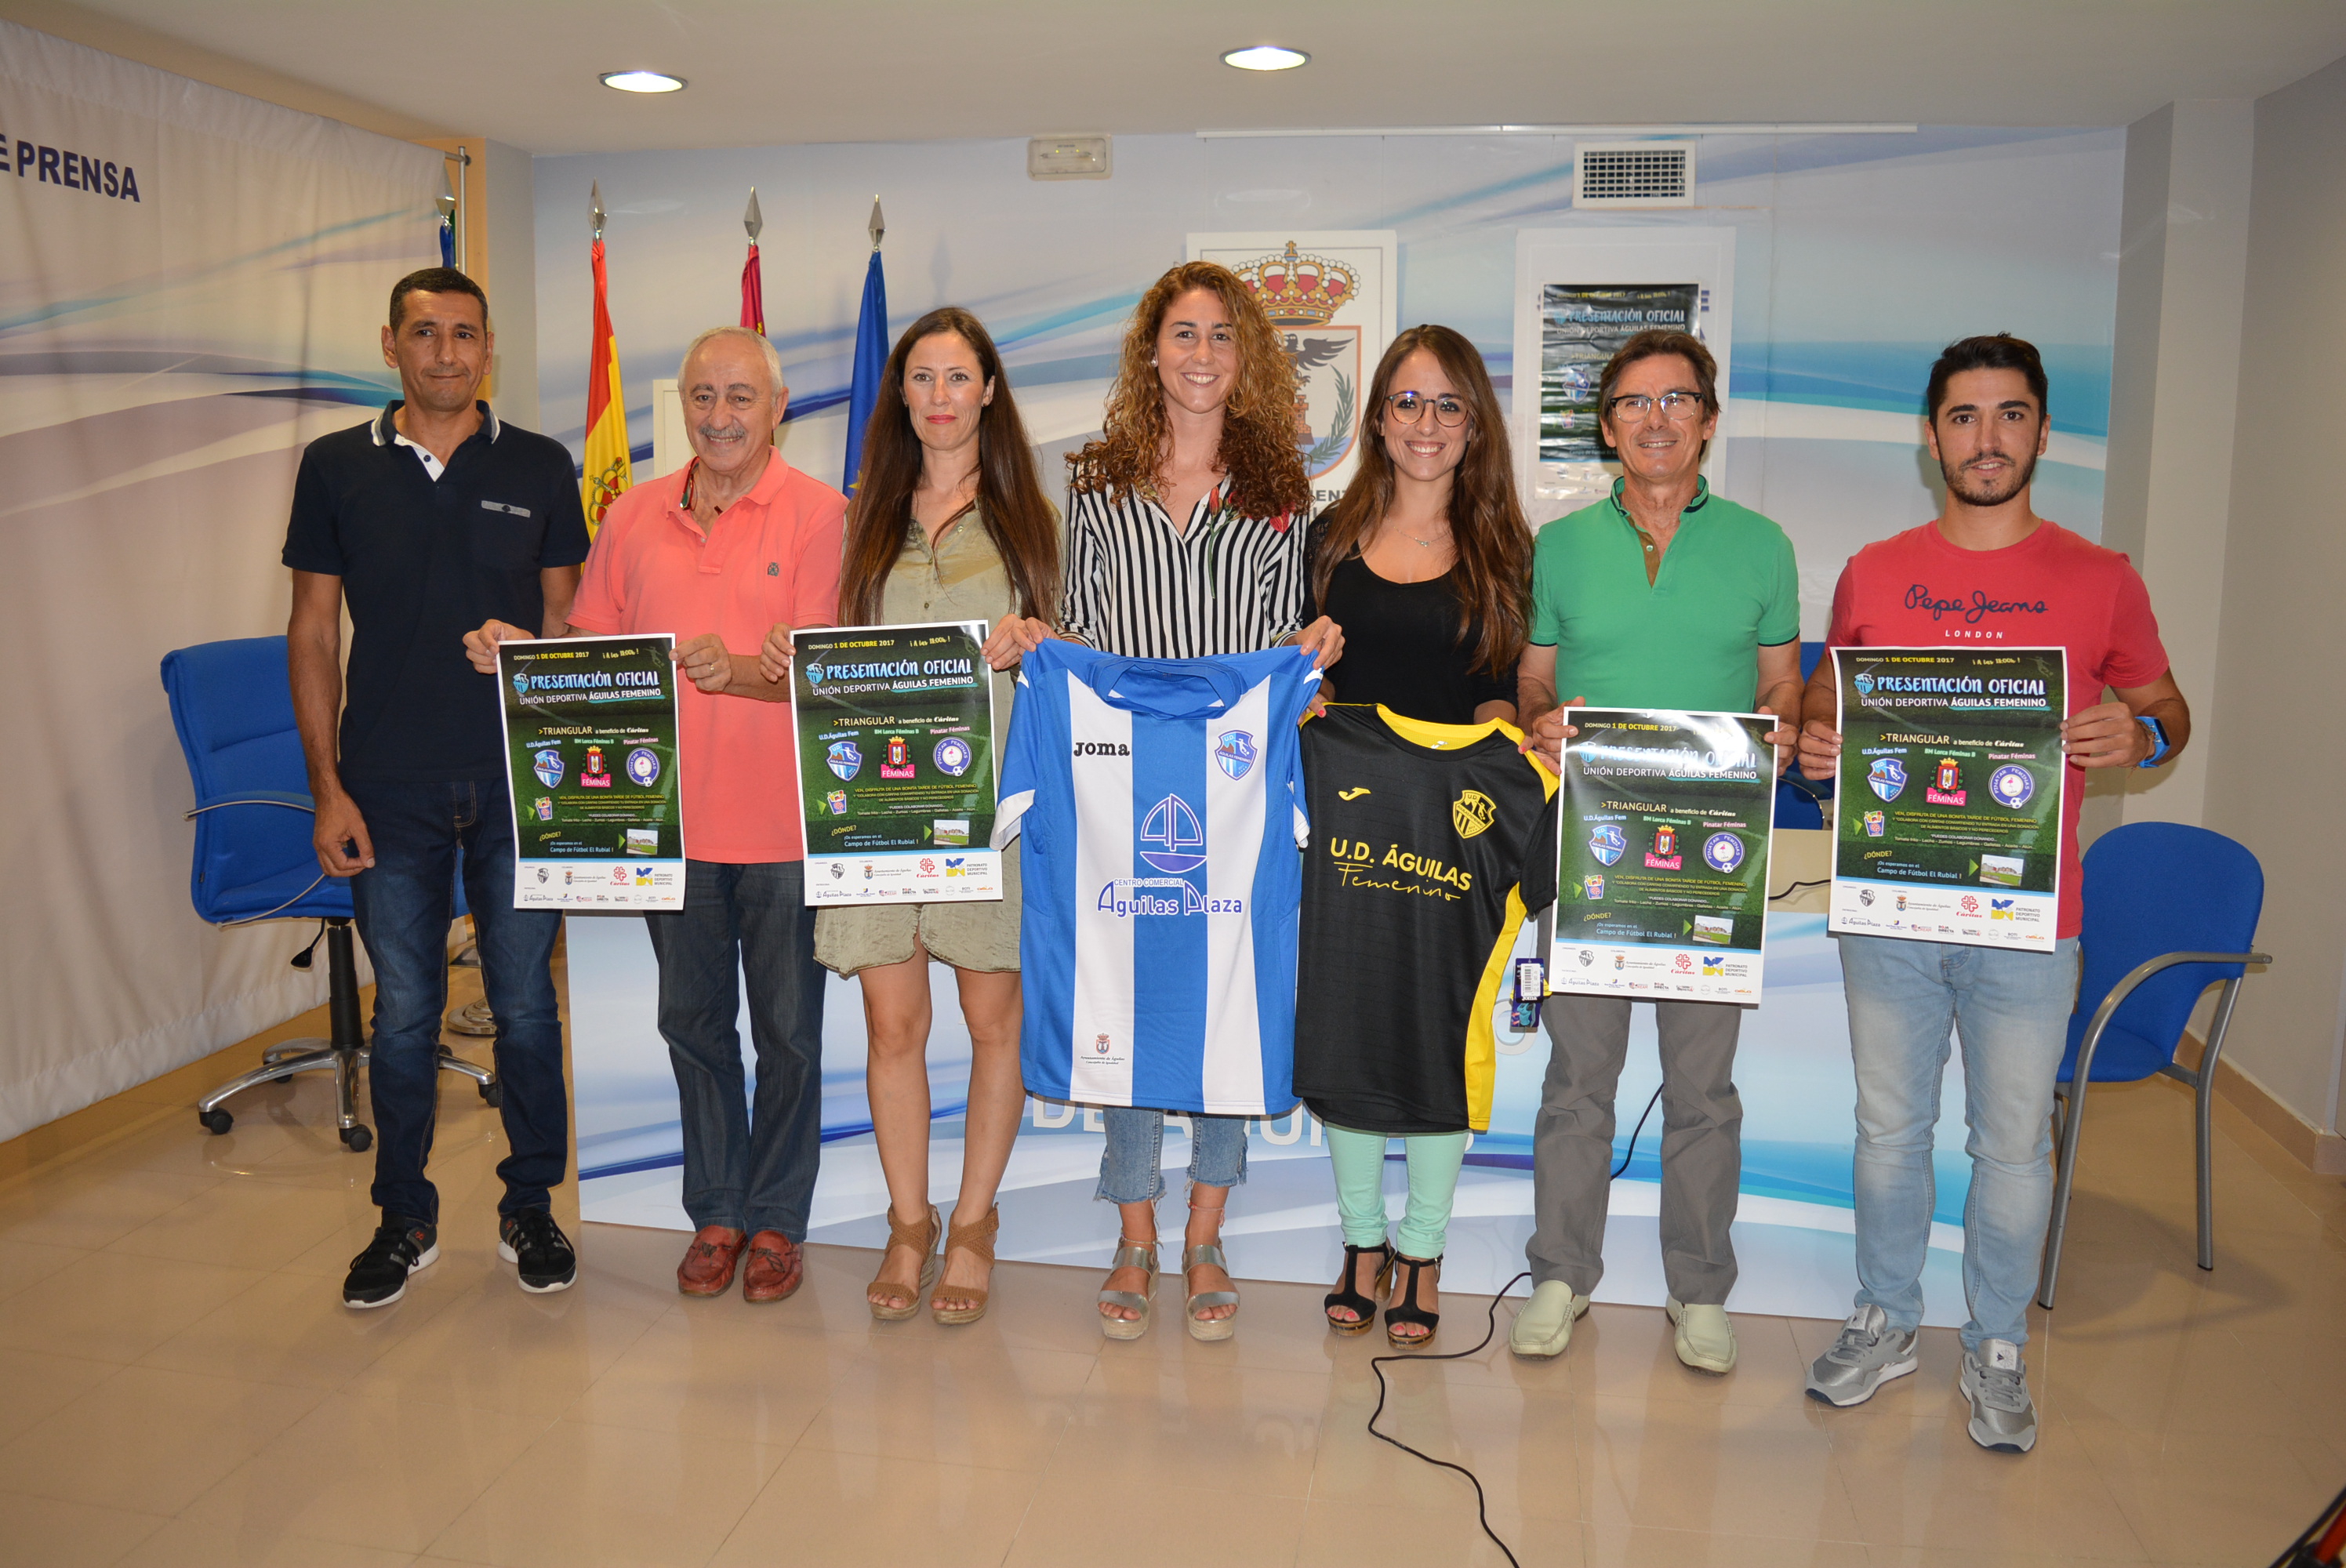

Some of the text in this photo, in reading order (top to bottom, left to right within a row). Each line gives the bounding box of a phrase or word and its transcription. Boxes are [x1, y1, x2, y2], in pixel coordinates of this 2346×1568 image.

[17, 140, 140, 203] PRENSA
[1647, 310, 1685, 322] OFICIAL
[1905, 584, 2049, 624] Pepe Jeans
[1945, 630, 2003, 638] LONDON
[826, 659, 972, 680] PRESENTACIÓN OFICIAL
[531, 671, 660, 690] PRESENTACIÓN OFICIAL
[812, 677, 974, 696] UNIÓN DEPORTIVA ÁGUILAS FEMENINO
[1877, 676, 2046, 696] PRESENTACIÓN OFICIAL
[520, 688, 661, 705] UNIÓN DEPORTIVA ÁGUILAS FEMENINO
[1861, 696, 2046, 707] UNIÓN DEPORTIVA ÁGUILAS FEMENINO
[883, 768, 913, 778] FÉMINAS
[1584, 765, 1757, 779] UNIÓN DEPORTIVA ÁGUILAS FEMENINO
[1927, 793, 1964, 804] FÉMINAS
[539, 831, 561, 841] ¿DÓNDE?
[831, 825, 857, 836] ¿DÓNDE?
[1864, 850, 1893, 859] ¿DÓNDE?
[1331, 837, 1473, 891] U.D. ÁGUILAS
[1647, 858, 1680, 869] FÉMINAS
[1334, 862, 1461, 902] Femenino
[1184, 880, 1242, 914] Plaza
[1584, 913, 1611, 922] ¿DÓNDE?
